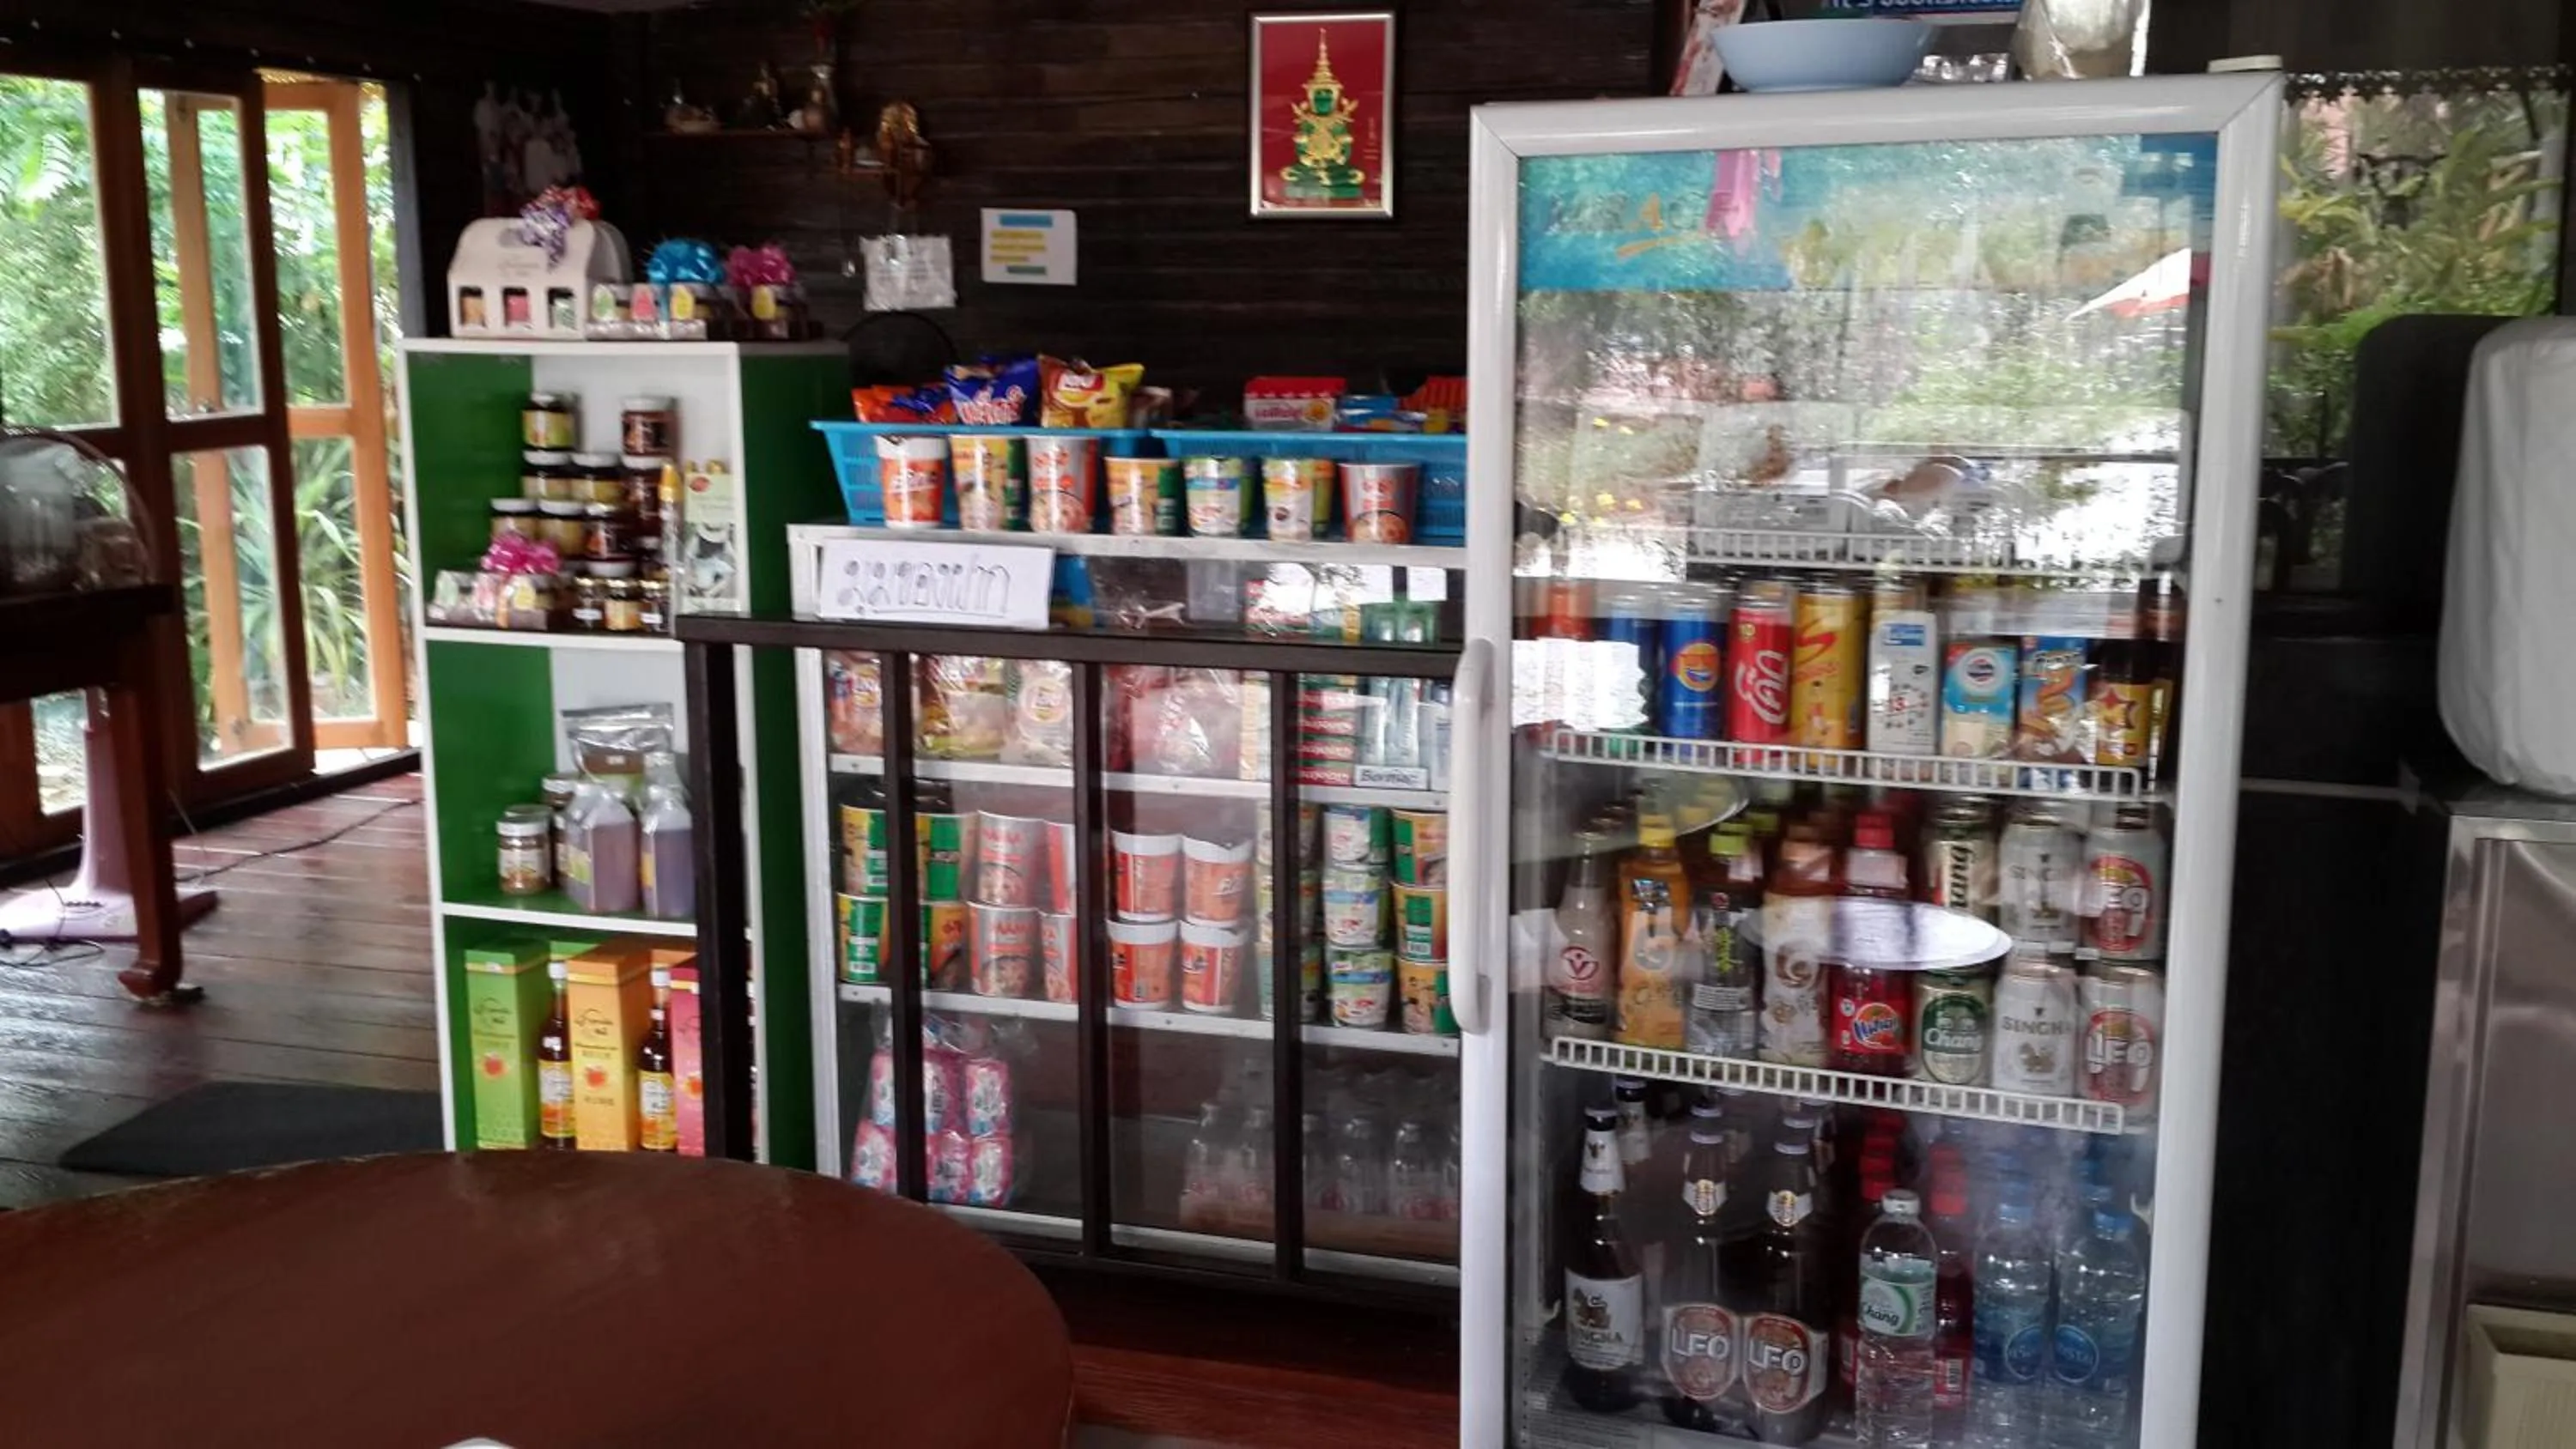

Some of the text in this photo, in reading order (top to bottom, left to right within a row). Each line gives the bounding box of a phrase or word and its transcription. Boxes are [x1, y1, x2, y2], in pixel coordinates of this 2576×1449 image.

[1949, 843, 1973, 908] ang
[1672, 1331, 1729, 1361] LEO
[1748, 1339, 1805, 1373] LEO
